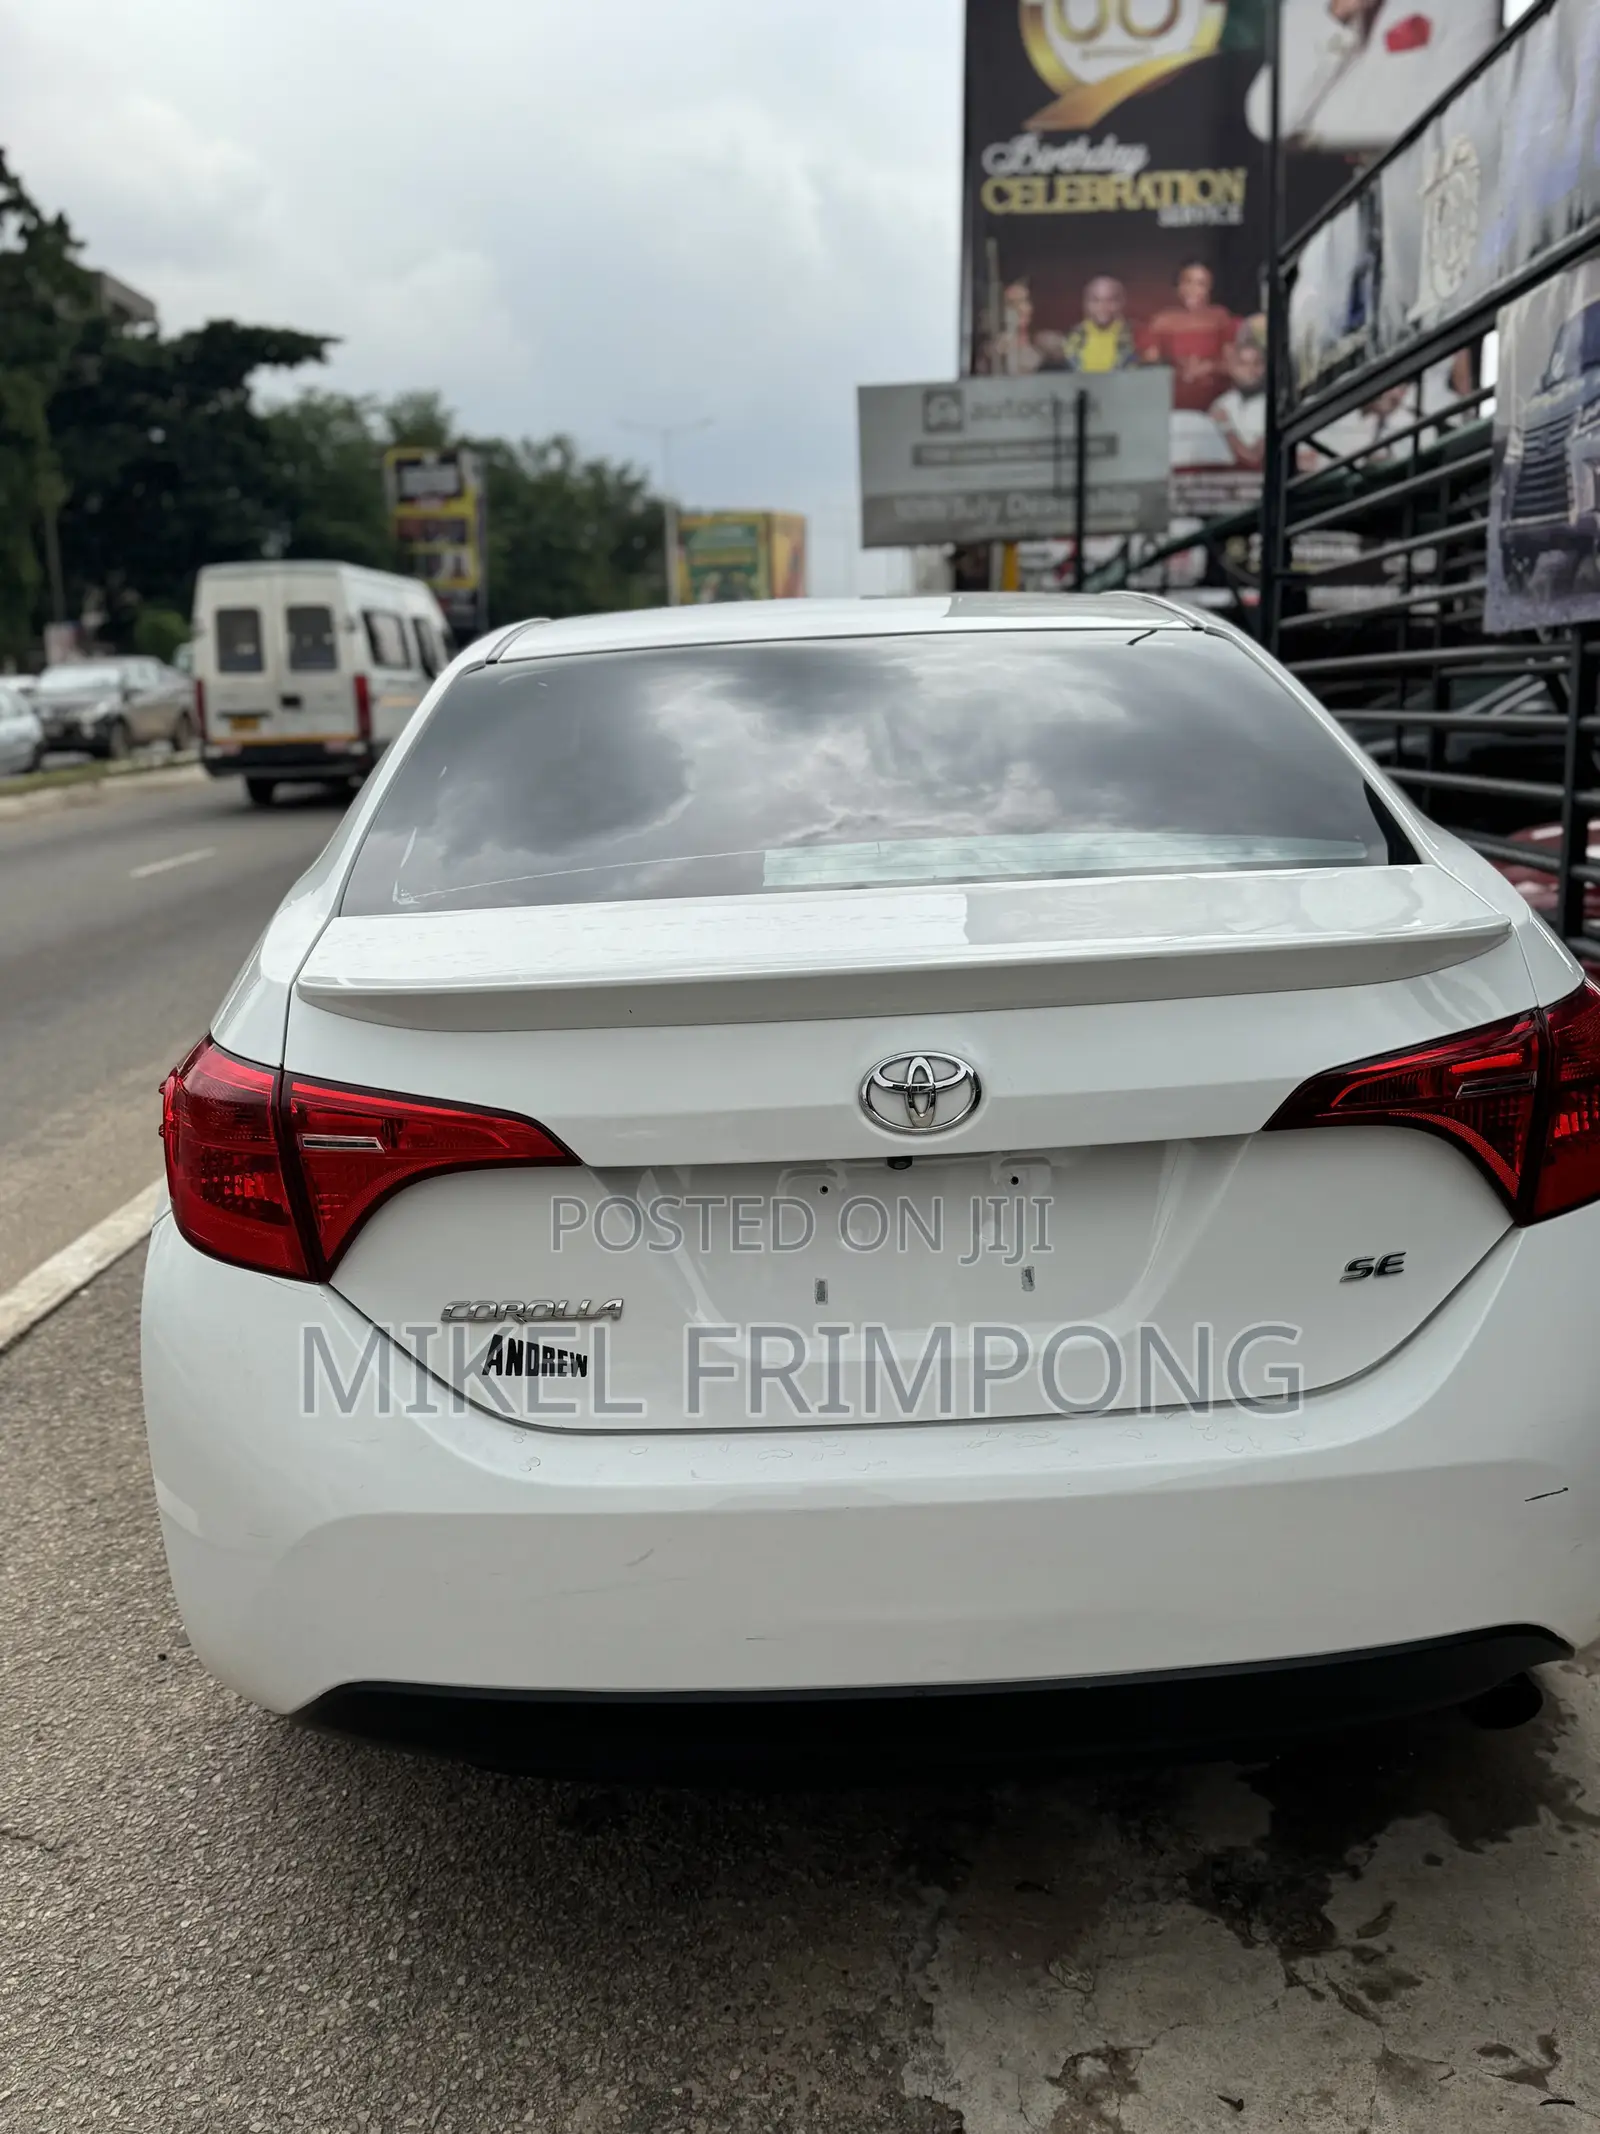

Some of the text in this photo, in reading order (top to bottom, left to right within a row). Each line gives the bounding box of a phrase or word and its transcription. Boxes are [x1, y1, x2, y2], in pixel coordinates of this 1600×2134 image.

[981, 132, 1151, 182] Birthday
[980, 168, 1248, 215] CELEBRATION
[1340, 1251, 1407, 1282] SE
[441, 1299, 624, 1324] COROLLA
[482, 1334, 588, 1378] ANDREW
